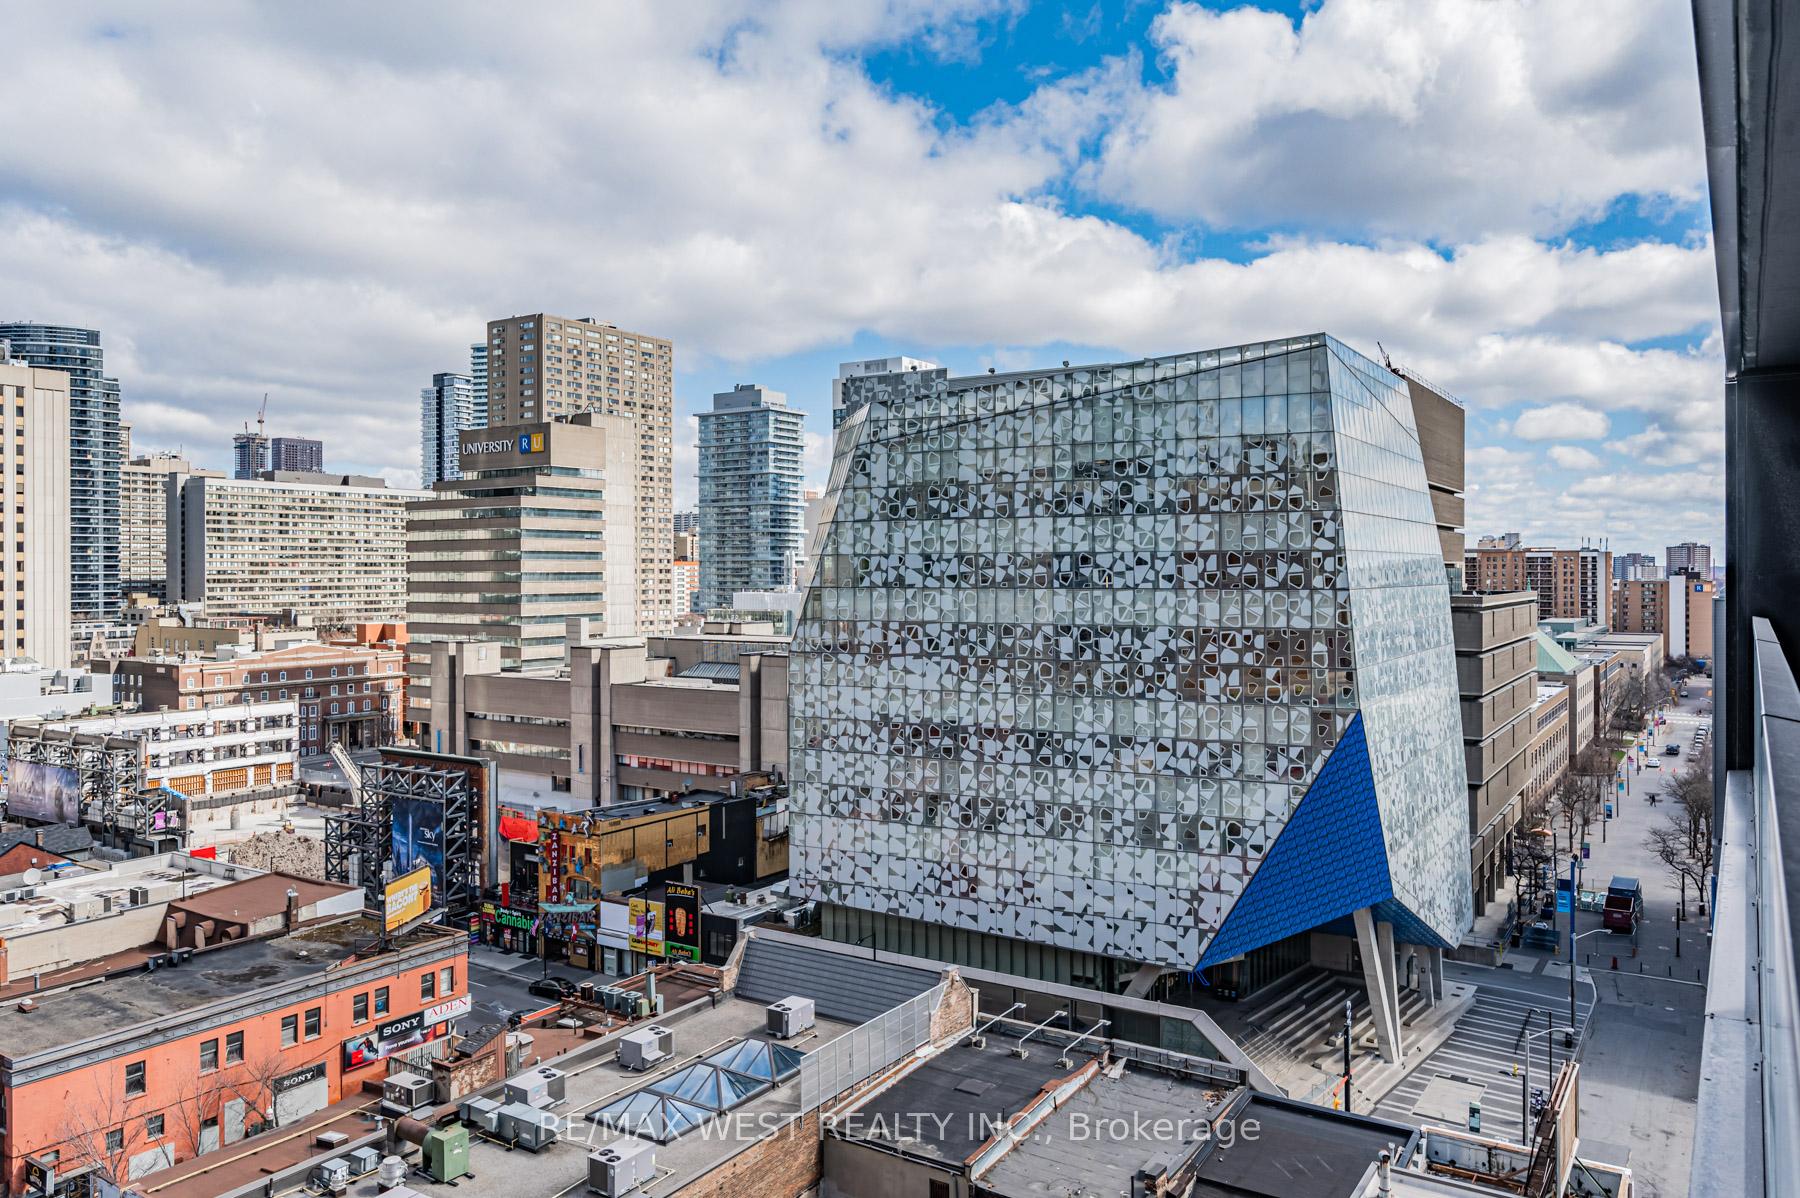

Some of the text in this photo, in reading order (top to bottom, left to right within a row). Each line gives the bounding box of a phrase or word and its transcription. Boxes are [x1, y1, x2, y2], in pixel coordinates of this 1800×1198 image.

[462, 437, 541, 455] UNIVERSITY R U
[667, 885, 676, 894] Ali
[495, 909, 534, 930] Cannabis
[541, 911, 594, 923] ZANZIBAR
[429, 999, 468, 1017] ADEN
[383, 1017, 420, 1036] SONY
[283, 1071, 314, 1087] SONY
